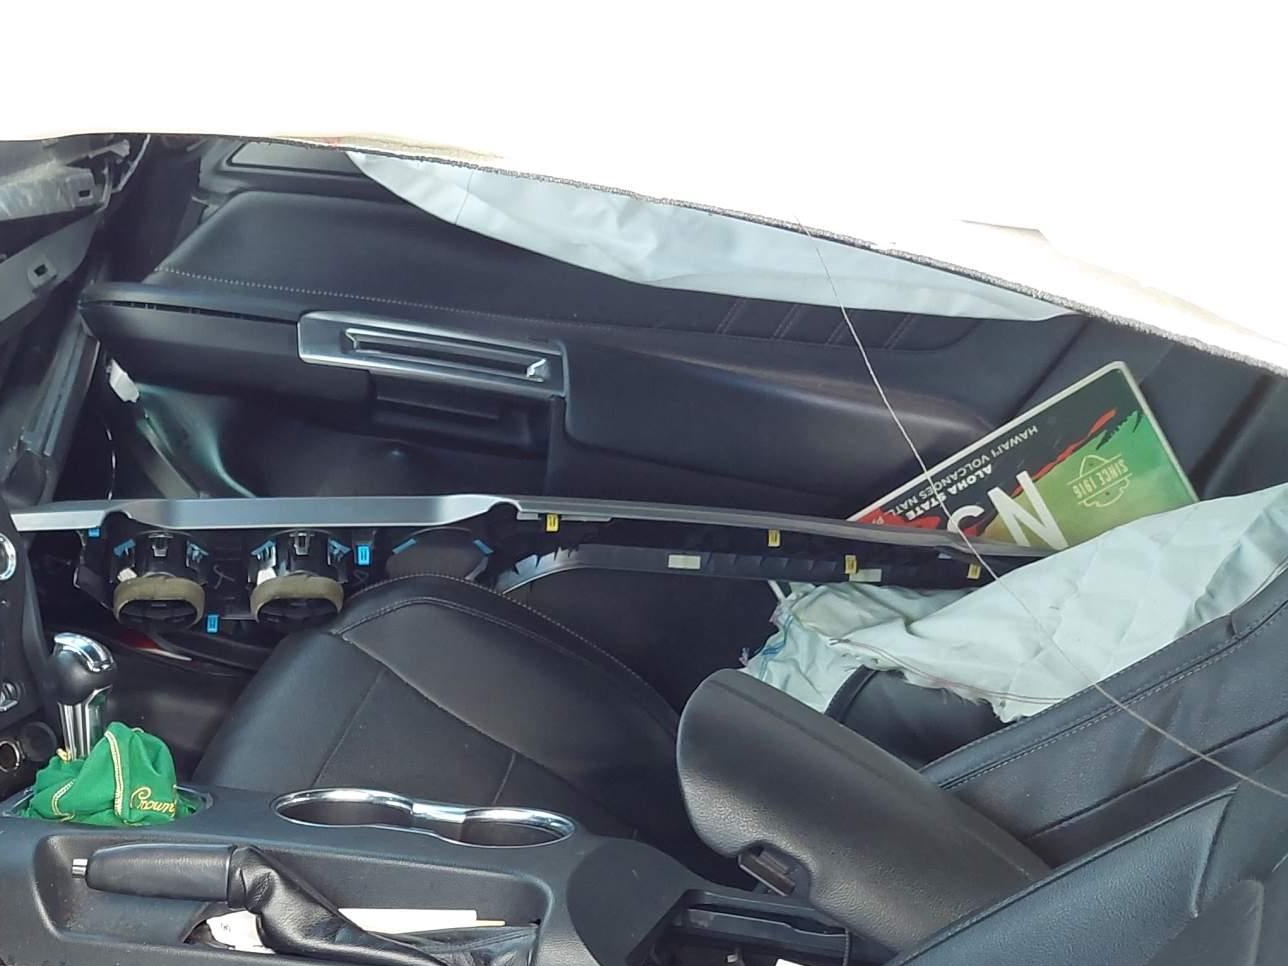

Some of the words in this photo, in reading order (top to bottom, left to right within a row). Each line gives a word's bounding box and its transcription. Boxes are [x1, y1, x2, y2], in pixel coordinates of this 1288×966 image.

[918, 453, 990, 500] VOLCANOES
[947, 464, 995, 496] ALOHA
[1094, 457, 1130, 487] SINCE
[1070, 475, 1099, 501] 1916
[905, 492, 948, 521] STATE
